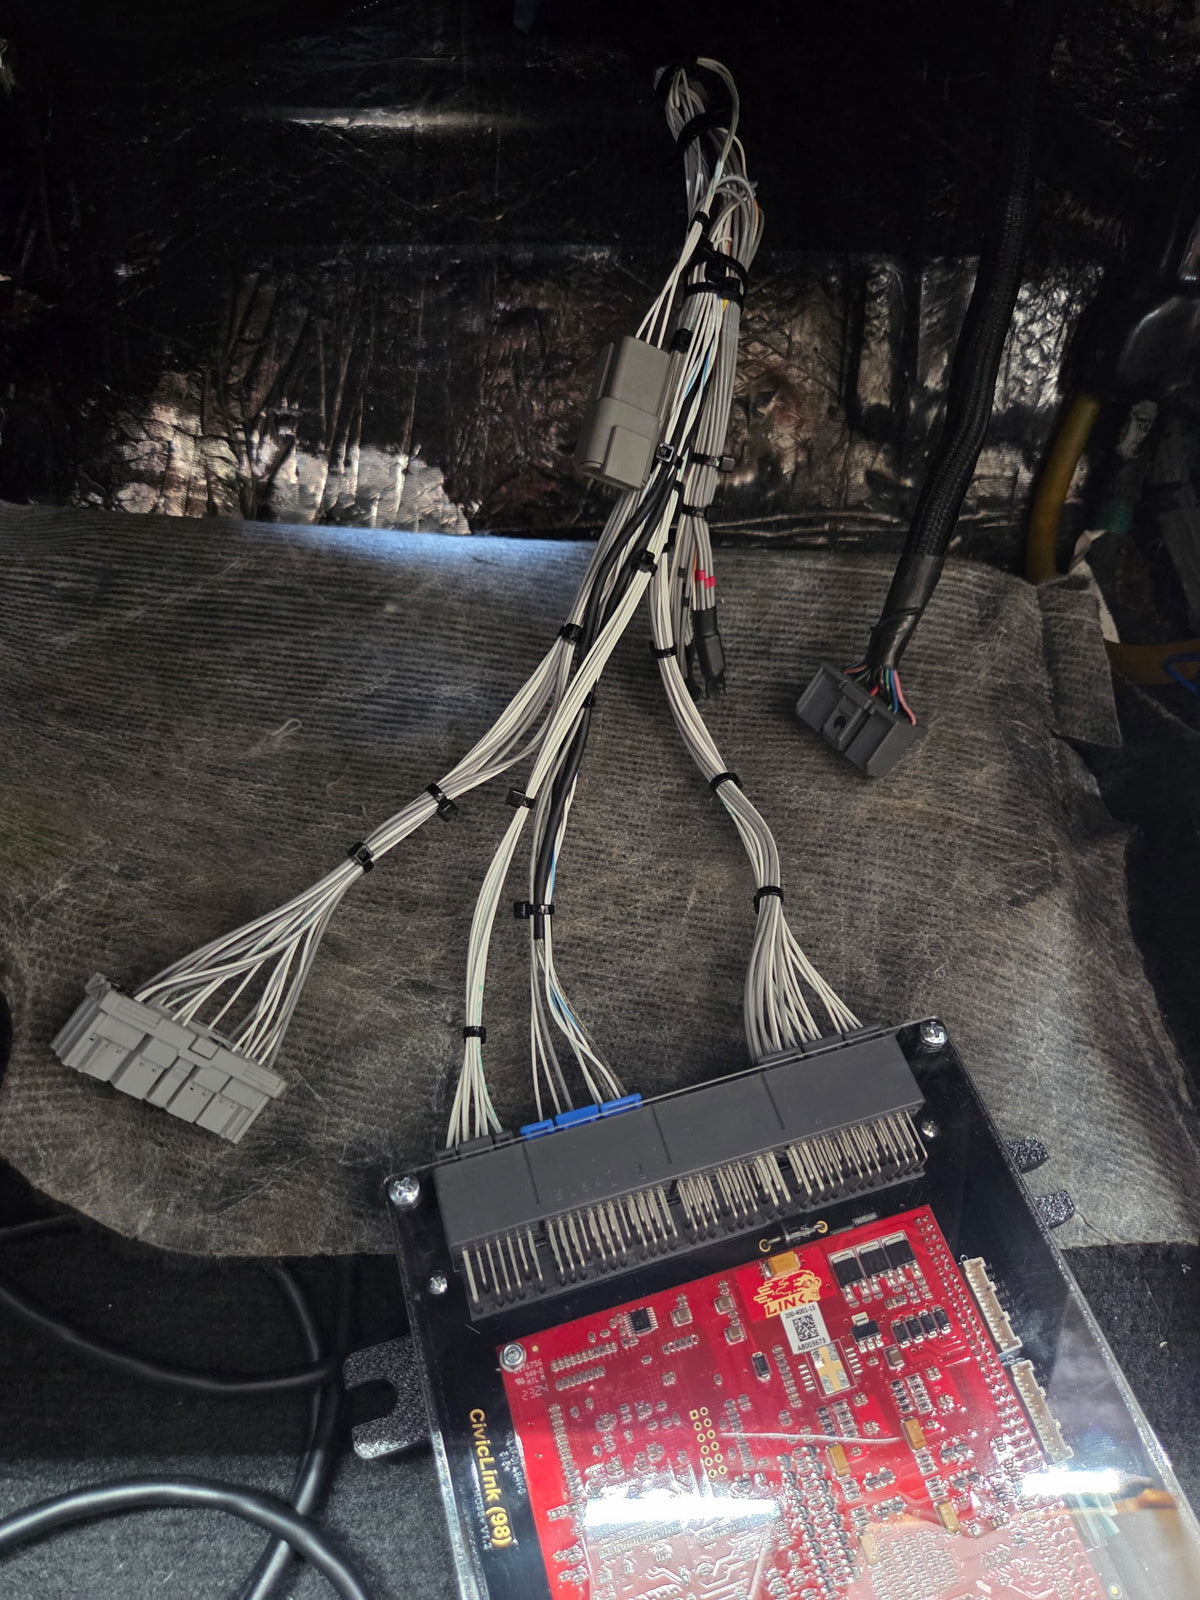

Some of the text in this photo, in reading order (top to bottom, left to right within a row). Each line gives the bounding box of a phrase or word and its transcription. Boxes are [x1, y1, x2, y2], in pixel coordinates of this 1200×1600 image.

[765, 1293, 808, 1315] LINK
[469, 1408, 502, 1502] CivicLink
[486, 1506, 514, 1549] (98)
